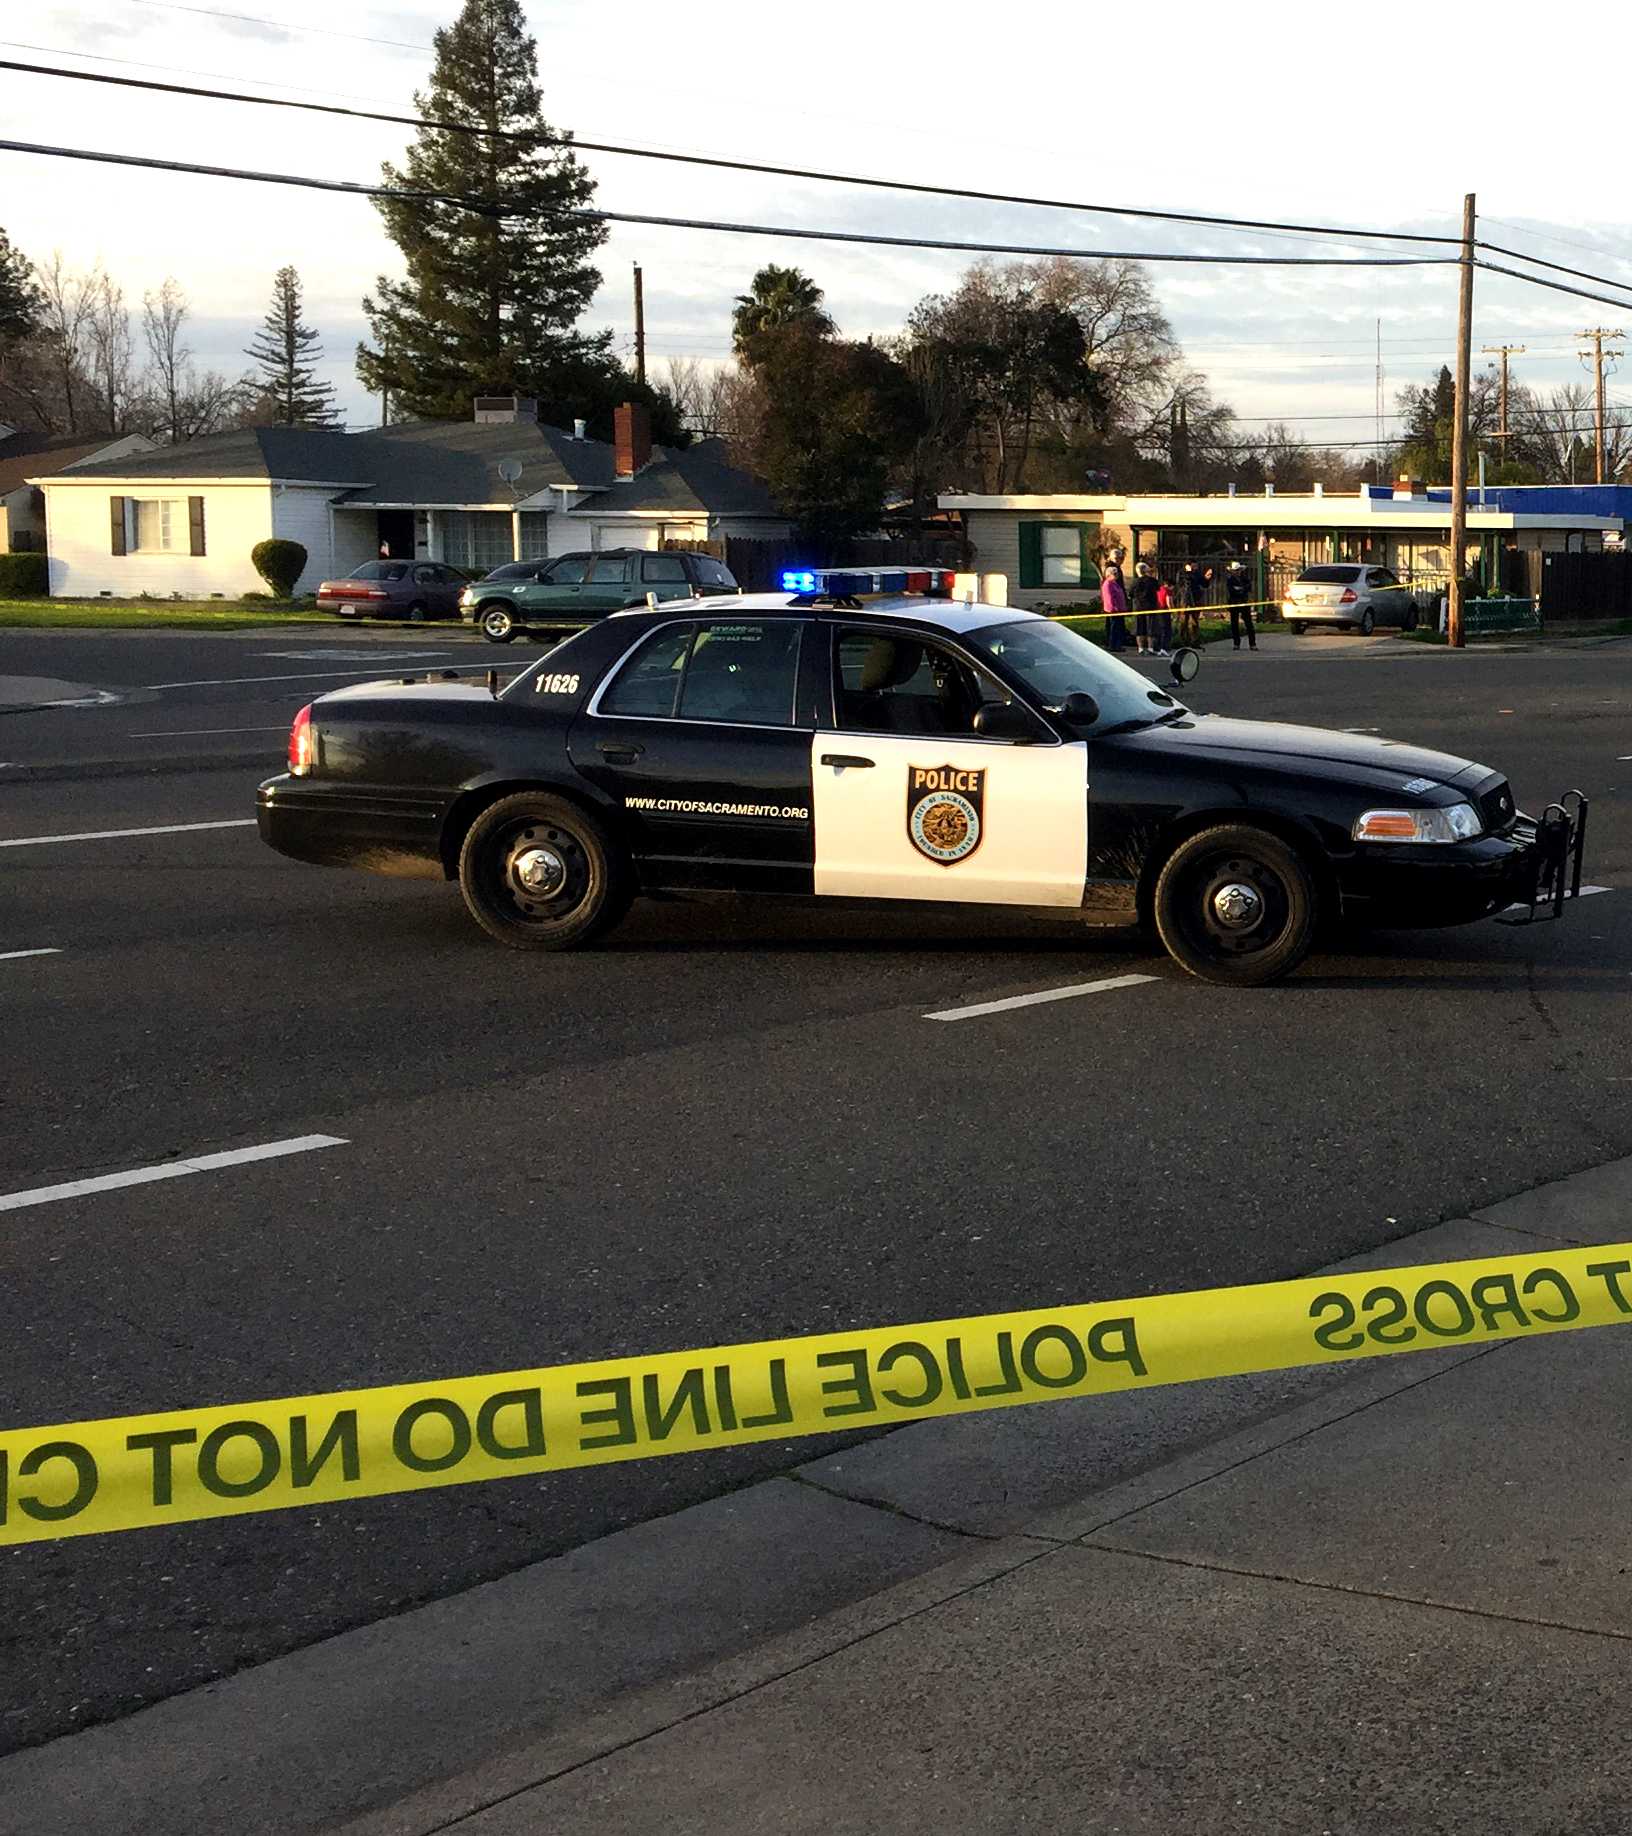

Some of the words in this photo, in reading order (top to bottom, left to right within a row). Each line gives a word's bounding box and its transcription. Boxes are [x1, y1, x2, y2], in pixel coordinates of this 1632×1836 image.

[535, 674, 580, 694] 11626
[915, 769, 979, 792] POLICE
[625, 797, 809, 819] WWW.CITYOFSACRAMENTO.ORG
